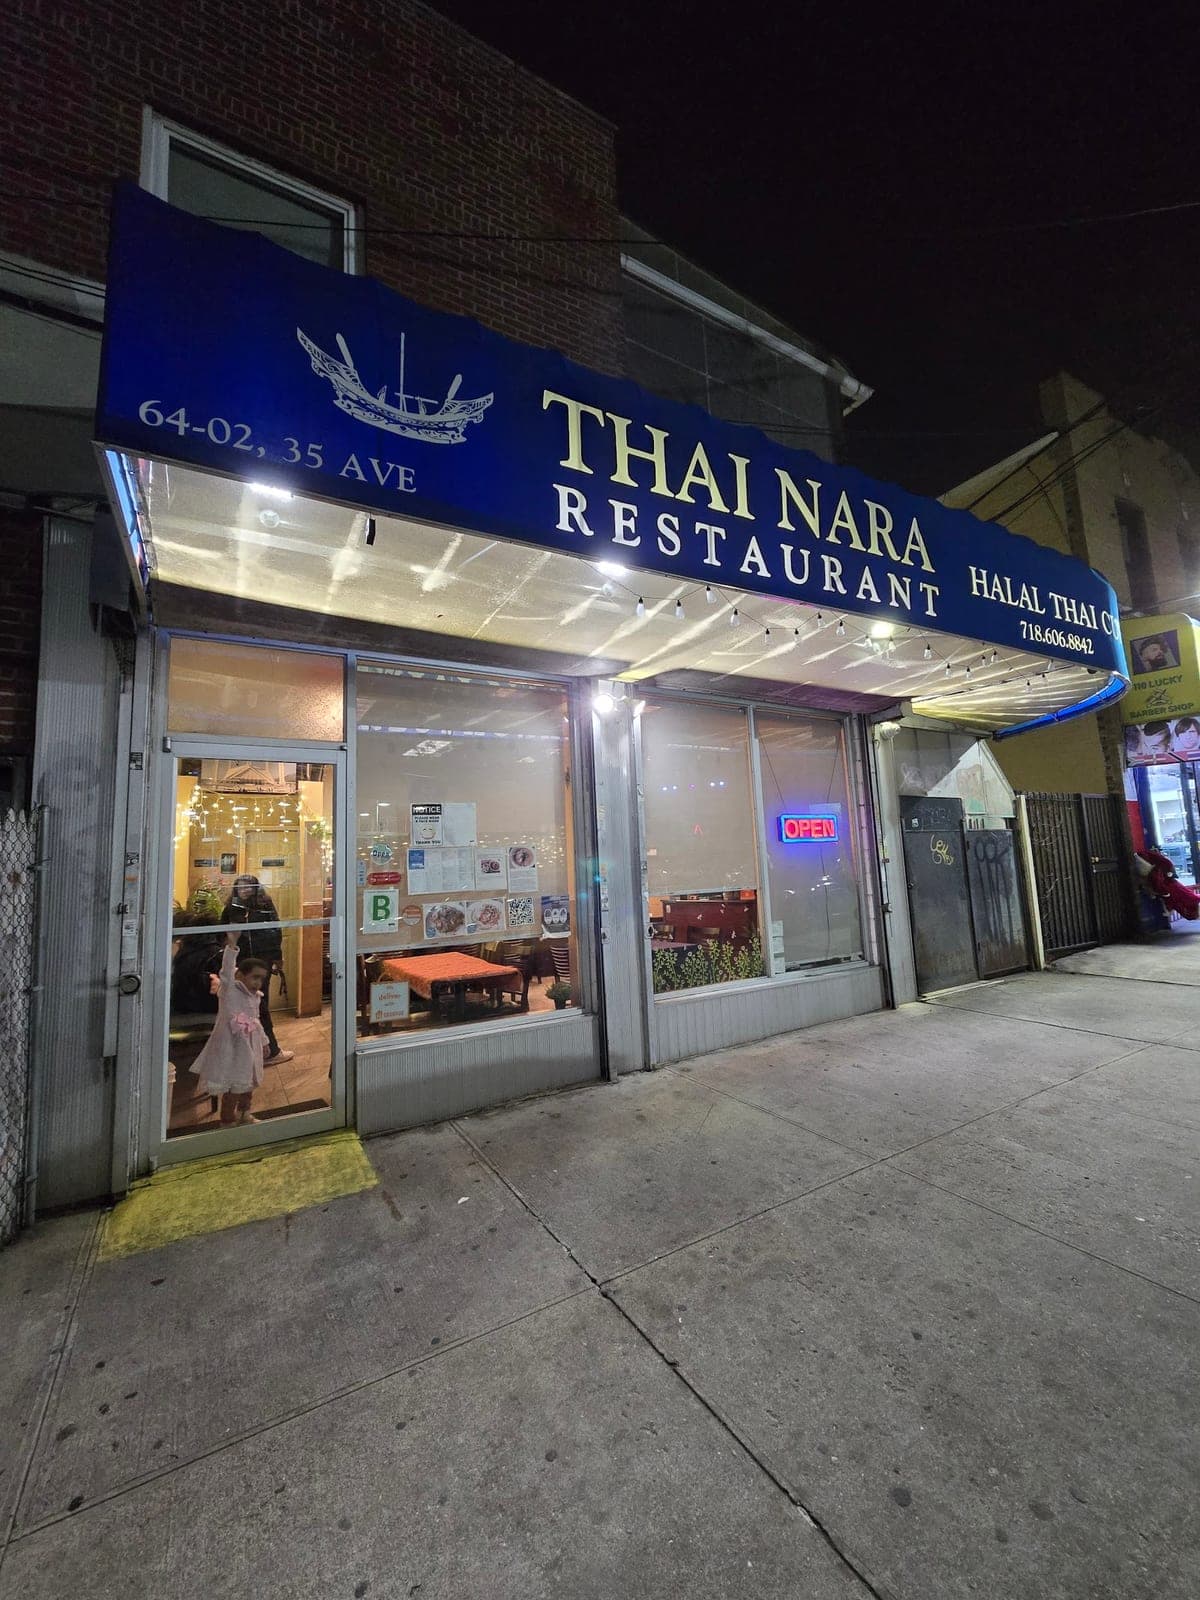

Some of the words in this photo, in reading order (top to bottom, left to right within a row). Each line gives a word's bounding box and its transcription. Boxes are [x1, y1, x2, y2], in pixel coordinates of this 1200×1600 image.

[138, 399, 266, 458] 64-02,
[283, 437, 323, 469] 35
[338, 453, 417, 494] AVE
[542, 389, 755, 520] THAI
[774, 467, 936, 573] NARA
[552, 483, 940, 617] RESTAURANT
[968, 565, 1046, 615] HALAL
[1049, 592, 1099, 630] THAI
[1019, 620, 1095, 655] 718.606.8842
[1149, 674, 1183, 688] LUCKY
[1129, 706, 1167, 719] BARBER
[1167, 702, 1194, 713] SHOP
[784, 818, 836, 839] OPEN
[372, 895, 391, 921] B
